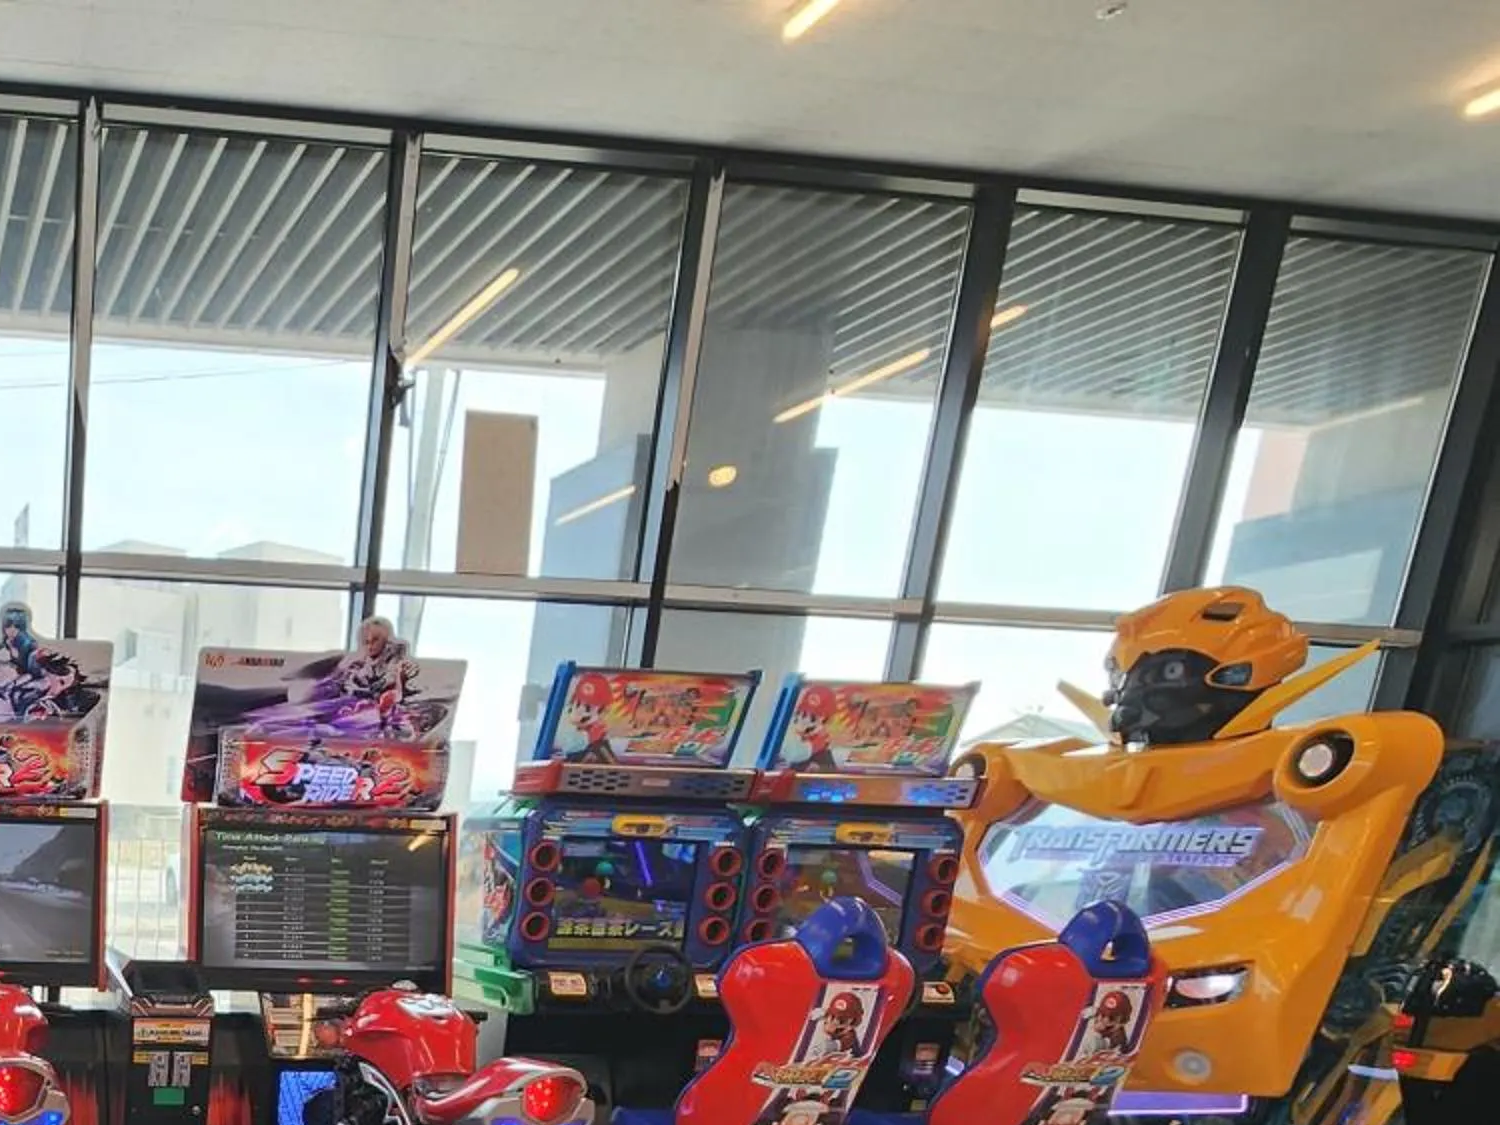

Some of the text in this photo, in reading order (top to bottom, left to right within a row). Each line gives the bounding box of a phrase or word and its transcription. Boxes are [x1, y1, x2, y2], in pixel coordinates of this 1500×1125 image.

[255, 748, 359, 785] SPEED
[303, 776, 377, 801] RIDER
[1006, 828, 1254, 865] TRANSFORMERS
